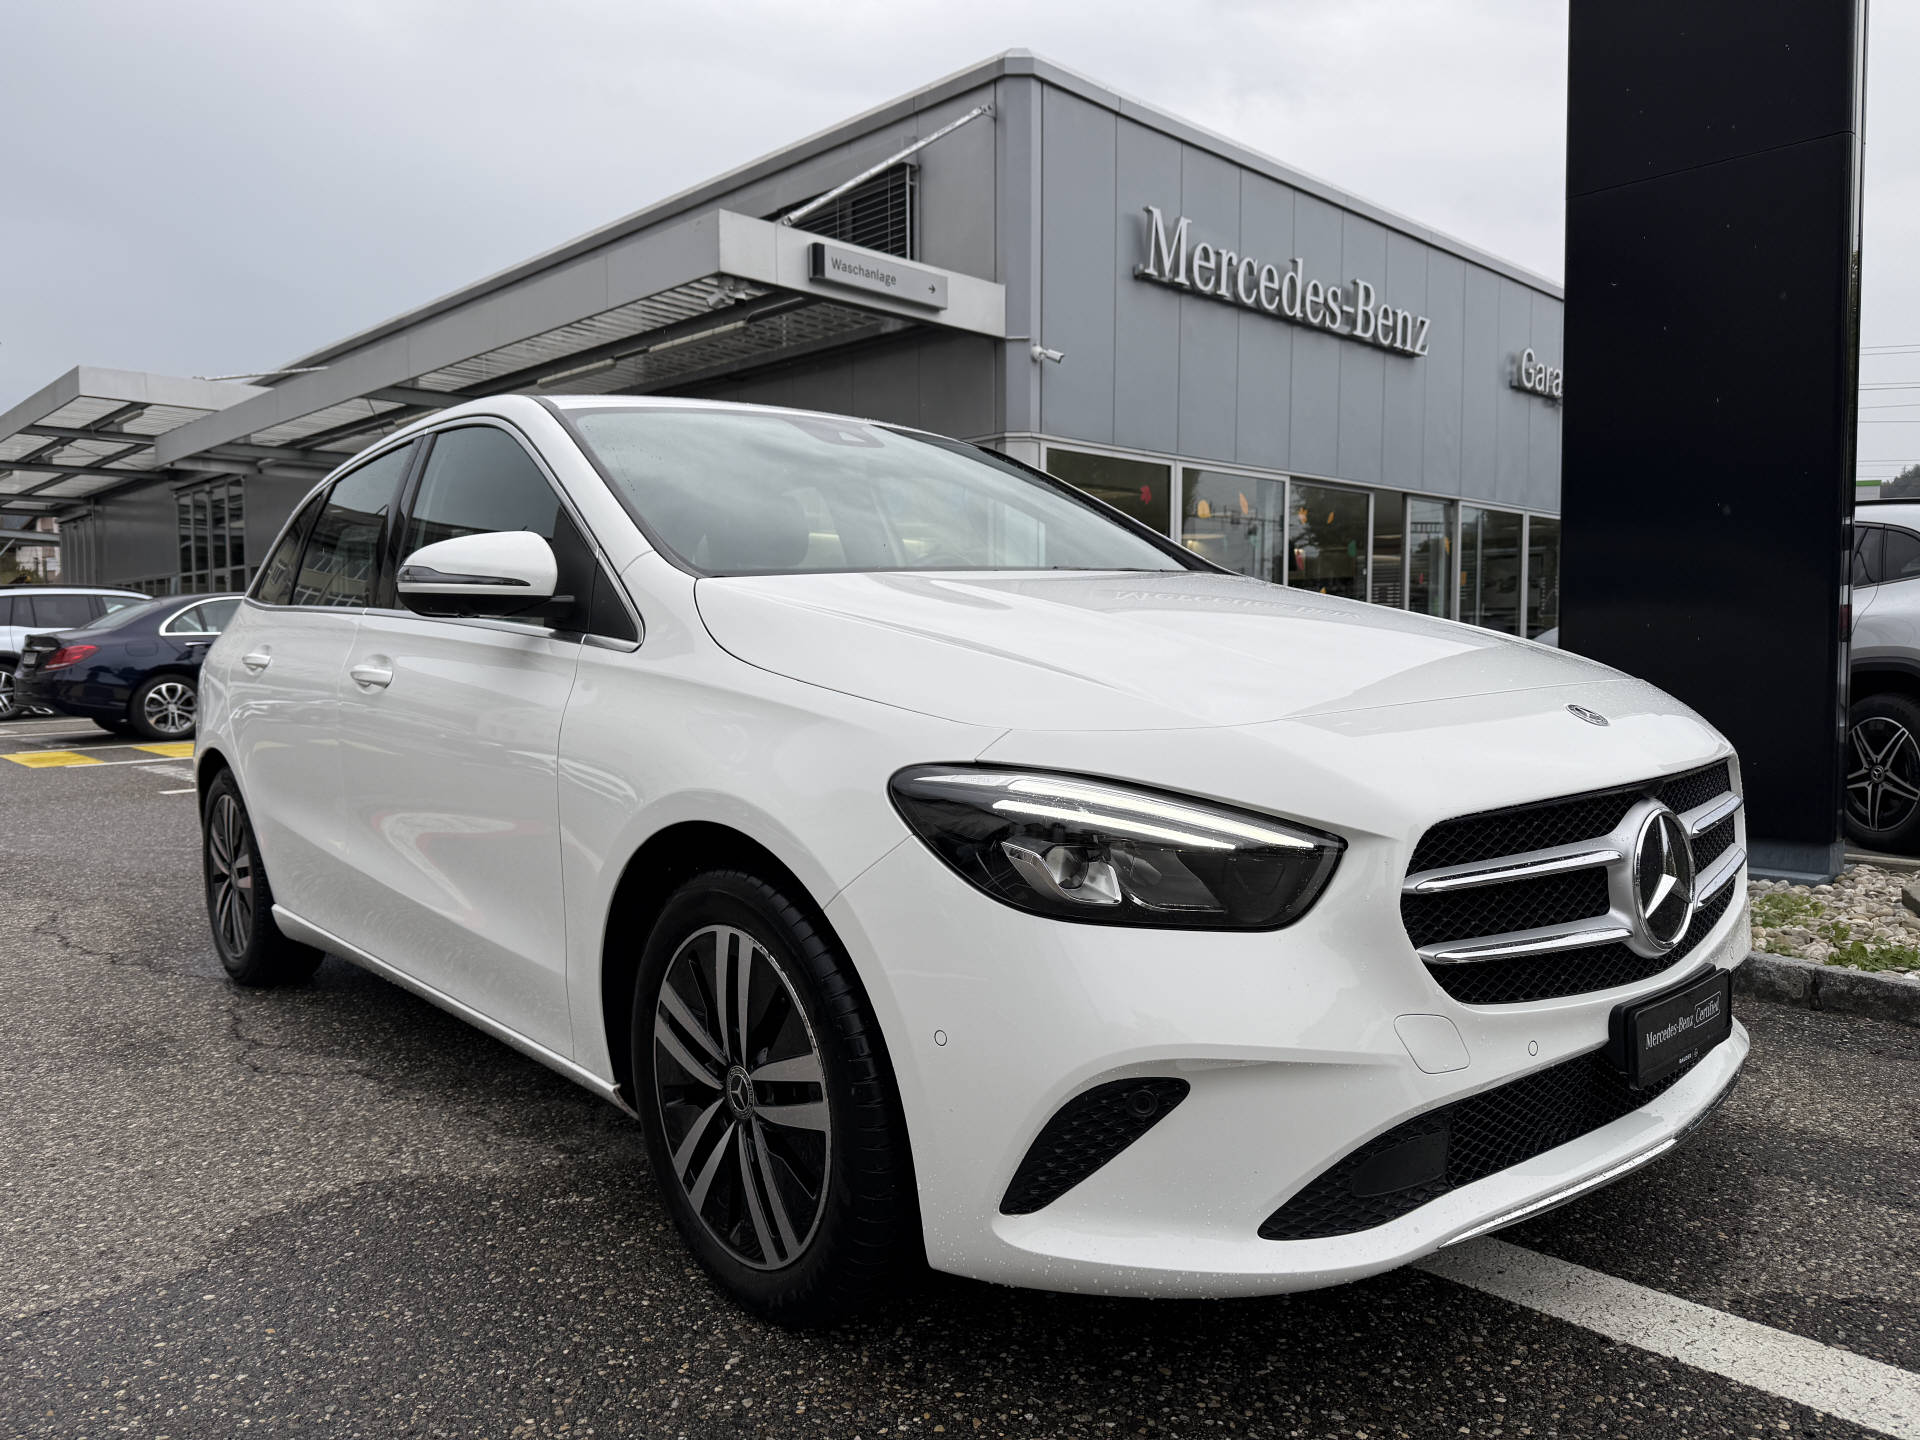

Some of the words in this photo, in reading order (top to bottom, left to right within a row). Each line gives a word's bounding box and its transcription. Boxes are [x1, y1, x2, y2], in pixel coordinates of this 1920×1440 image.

[831, 257, 897, 287] Waschanlage
[1143, 204, 1431, 357] Mercedes-Benz
[1645, 1015, 1694, 1050] Mercedes-Benz
[1695, 995, 1720, 1023] Certified
